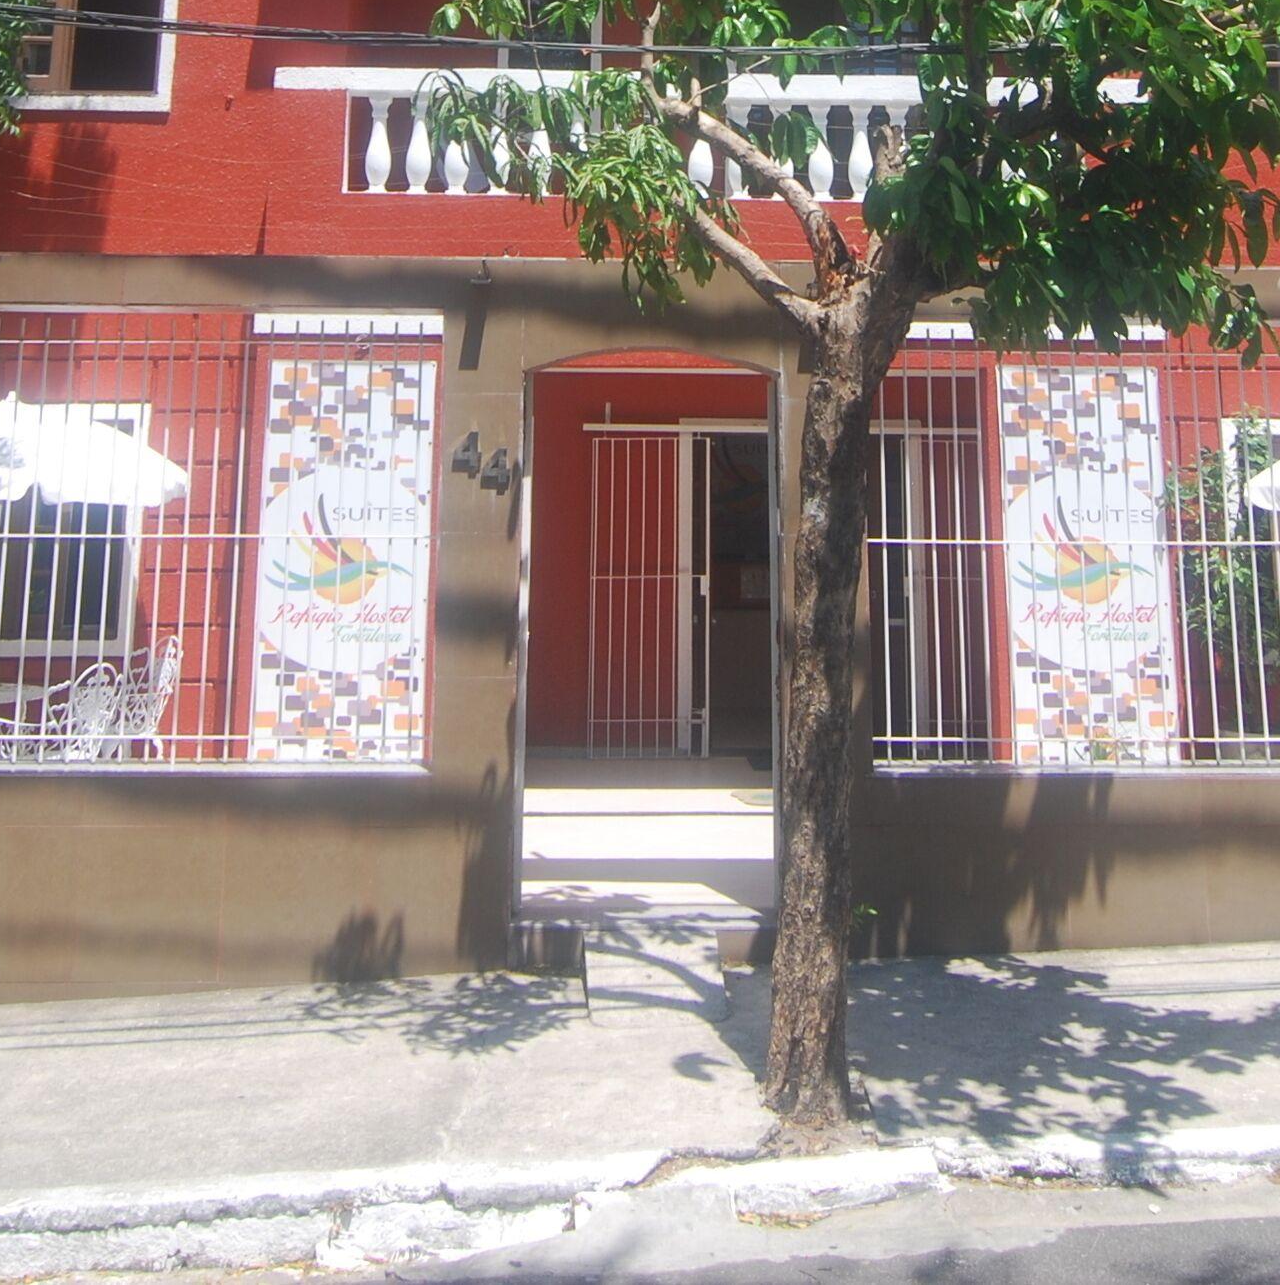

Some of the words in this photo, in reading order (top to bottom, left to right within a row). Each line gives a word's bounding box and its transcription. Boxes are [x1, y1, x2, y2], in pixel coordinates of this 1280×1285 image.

[451, 431, 510, 496] 44
[349, 602, 414, 624] Hostel
[1096, 602, 1158, 624] Hostel
[1079, 624, 1150, 642] Fortalea
